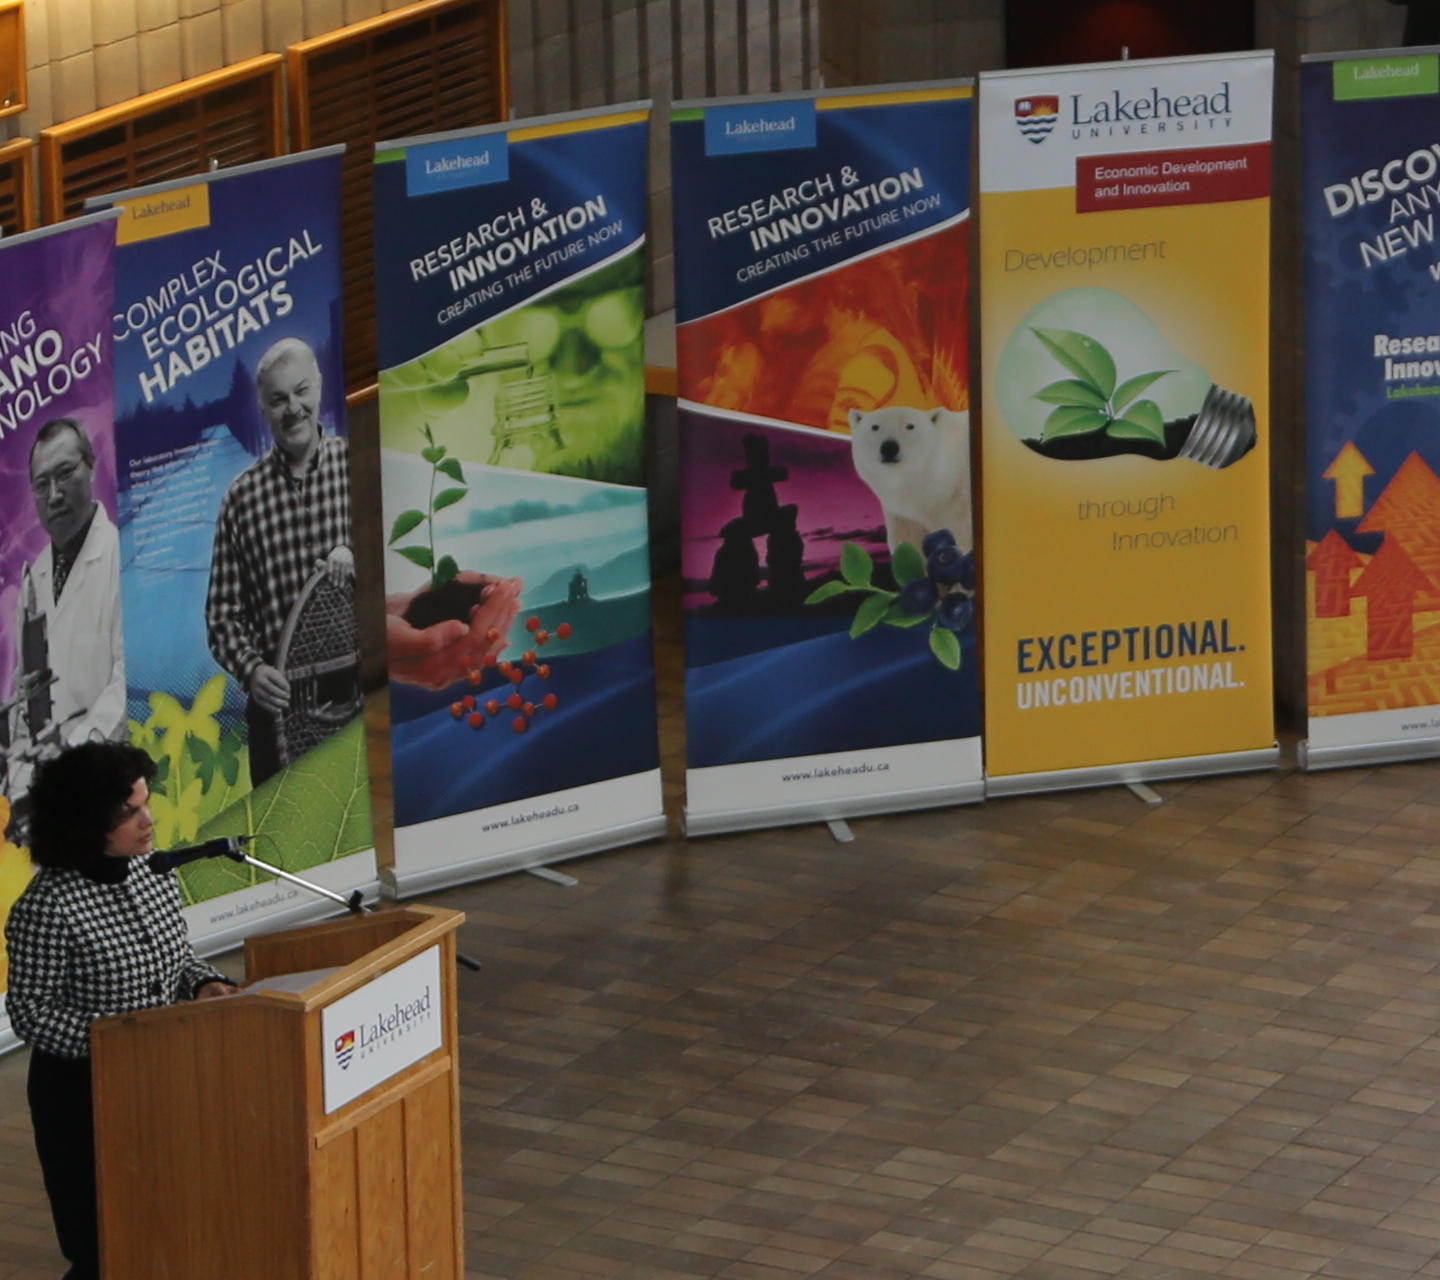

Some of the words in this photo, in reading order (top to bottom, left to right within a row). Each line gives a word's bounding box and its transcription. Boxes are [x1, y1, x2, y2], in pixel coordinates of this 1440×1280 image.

[1354, 64, 1420, 80] Lakehead
[726, 117, 795, 135] Lakehead
[1071, 82, 1231, 126] Lakehead
[1072, 116, 1232, 139] UNIVERSITY
[426, 151, 489, 174] Lakehead
[1095, 164, 1159, 180] Economic
[1162, 157, 1248, 175] Development
[132, 194, 190, 220] Lakehead
[707, 173, 835, 238] RESEARCH
[840, 166, 859, 186] &
[750, 168, 924, 251] INNOVATION
[1095, 184, 1119, 198] and
[1123, 180, 1190, 195] Innovation
[410, 207, 526, 280] RESEARCH
[530, 198, 548, 220] &
[449, 194, 608, 291] INNOVATION
[737, 244, 810, 282] CREATING
[812, 228, 843, 252] THE
[845, 211, 900, 240] FUTURE
[903, 193, 941, 218] NOW
[1004, 241, 1167, 272] Development
[1360, 214, 1434, 268] NEW
[142, 230, 322, 360] ECOLOGICAL
[437, 282, 504, 325] CREATING
[505, 266, 533, 290] THE
[534, 239, 586, 274] FUTURE
[588, 220, 623, 247] NOW
[113, 250, 227, 341] COMPLEX
[139, 281, 293, 403] HABITATS
[1077, 492, 1176, 520] through
[1111, 524, 1238, 552] Innovation
[1017, 619, 1246, 674] EXCEPTIONAL.
[1017, 660, 1246, 711] UNCONVENTIONAL.
[782, 760, 890, 783] www.lakeheadu.ca
[481, 801, 580, 834] www.lakeheadu.ca
[210, 889, 298, 923] www.lakeheadu.ca
[359, 985, 431, 1048] Lakehead
[361, 1012, 432, 1059] UNIVERSITY
